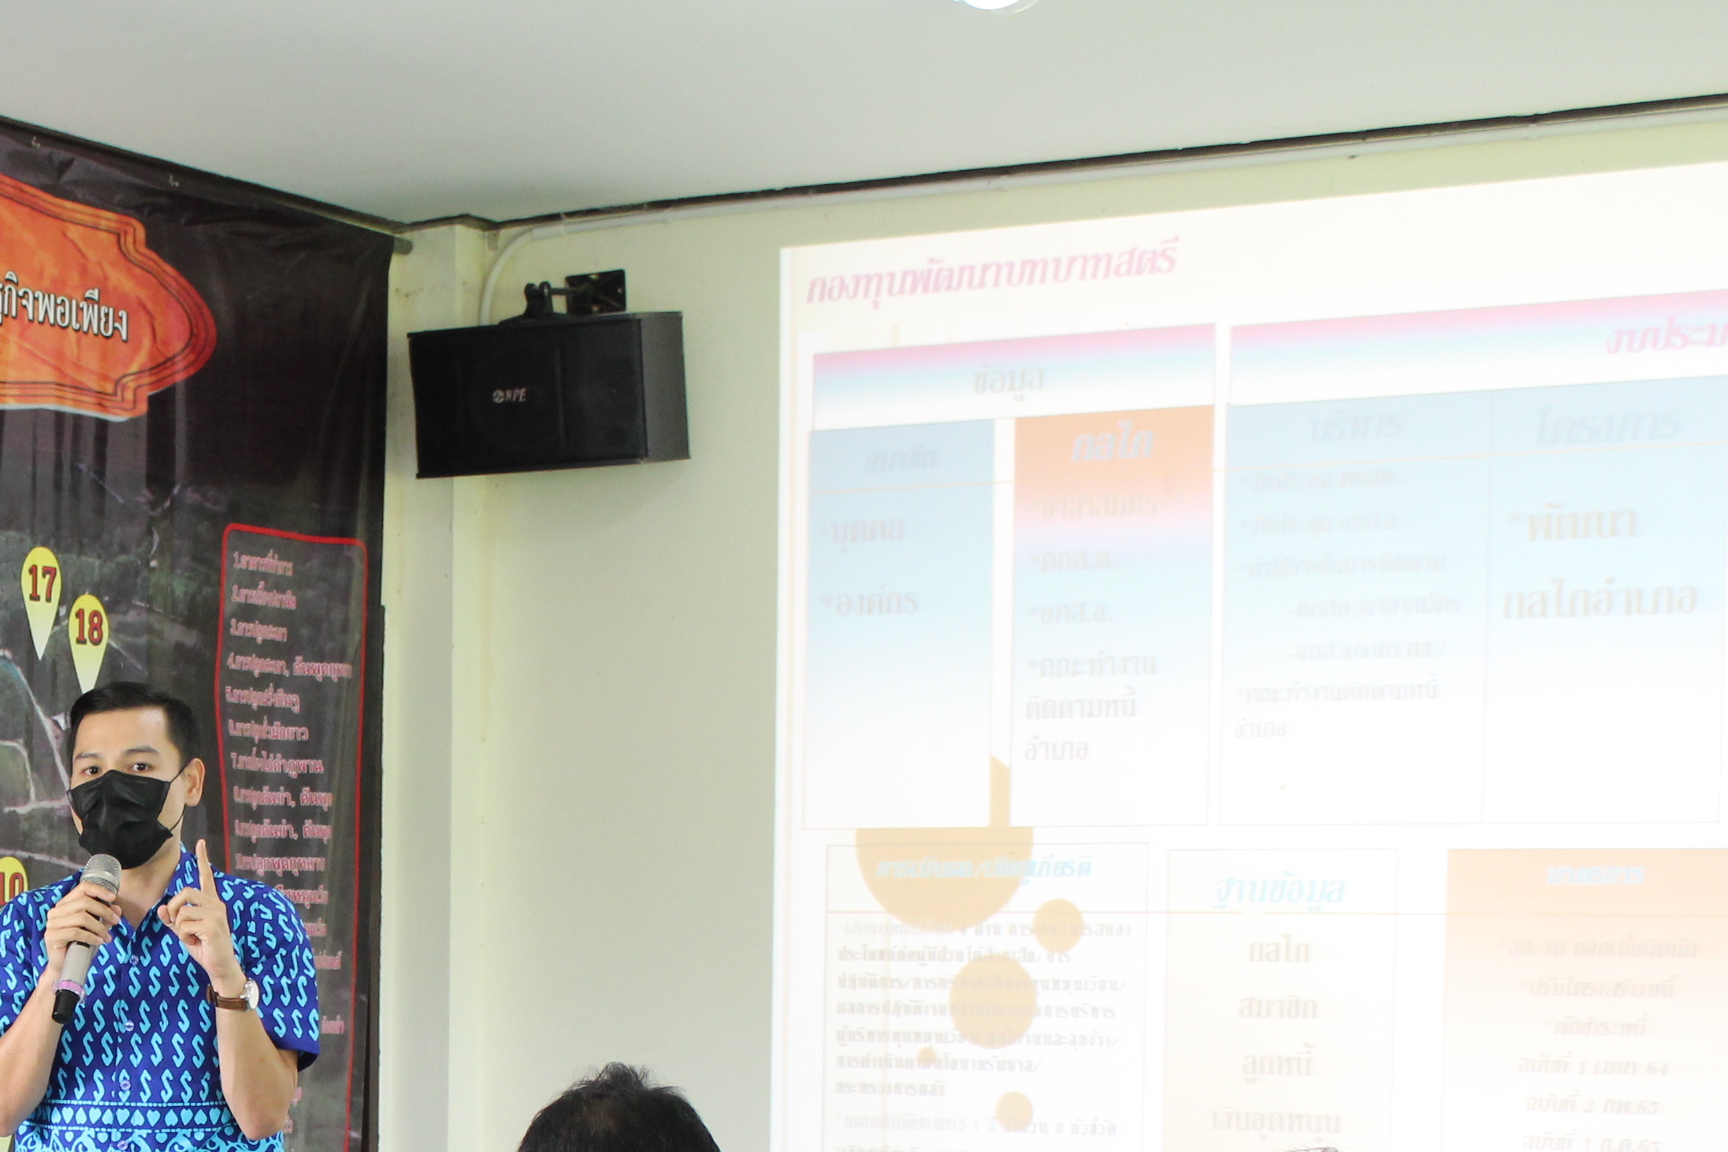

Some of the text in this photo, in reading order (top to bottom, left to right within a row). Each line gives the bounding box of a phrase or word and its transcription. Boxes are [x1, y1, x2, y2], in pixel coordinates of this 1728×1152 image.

[805, 236, 1181, 309] กองทุนพัฒนาบทบาทสตรี
[972, 364, 1045, 401] ข้อมูล
[1071, 421, 1154, 463] กลไก
[1535, 406, 1682, 448] โครงการ
[1527, 501, 1639, 542] พัฒนา
[28, 565, 57, 602] 17
[836, 581, 919, 615] องค์กร
[1502, 577, 1701, 621] กลไกอำเภอ
[74, 608, 104, 646] 18
[1039, 649, 1158, 679] คณะทำงาน
[1024, 688, 1138, 721] ติดตามหนี้
[1233, 716, 1289, 739] อำเภอ
[1024, 734, 1090, 762] อำเภอ
[1213, 870, 1346, 912] ฐานข้อมูล
[1247, 932, 1312, 963] กลไก
[1237, 994, 1319, 1020] สมาชิก
[1241, 1042, 1313, 1085] ลูกหนี้
[1211, 1105, 1343, 1142] เงินอุดหนุน
